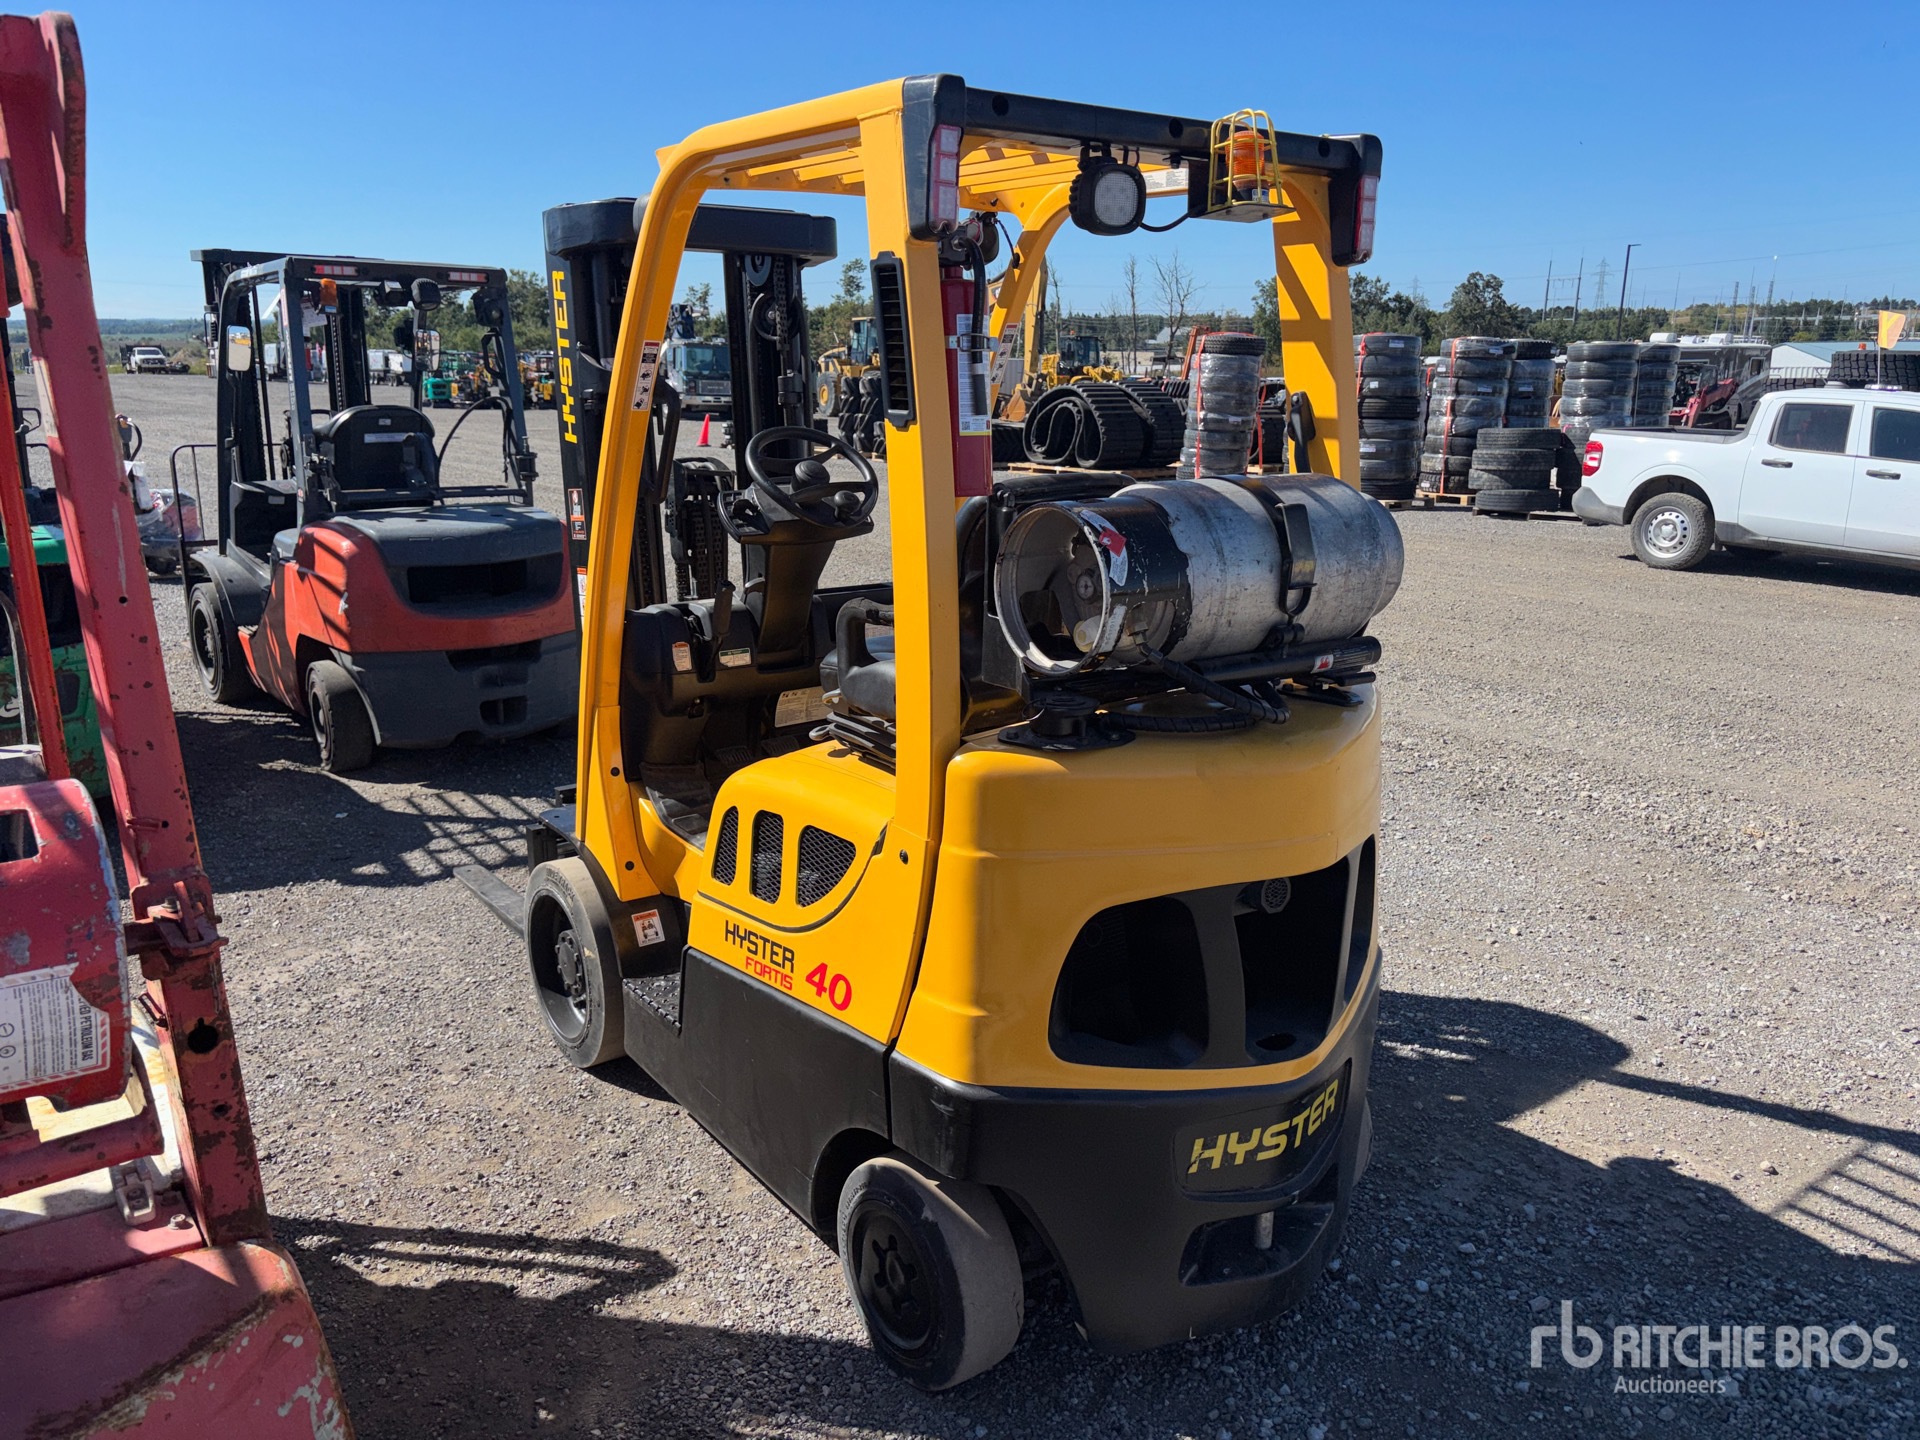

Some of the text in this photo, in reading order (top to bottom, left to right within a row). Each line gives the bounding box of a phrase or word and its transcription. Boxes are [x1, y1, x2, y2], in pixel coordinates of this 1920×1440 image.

[551, 270, 578, 444] HYSTER
[725, 919, 795, 974] HYSTER
[745, 955, 794, 991] FORTIS
[805, 962, 853, 1011] 40
[81, 1049, 94, 1061] GAS
[1187, 1079, 1339, 1174] HYSTER
